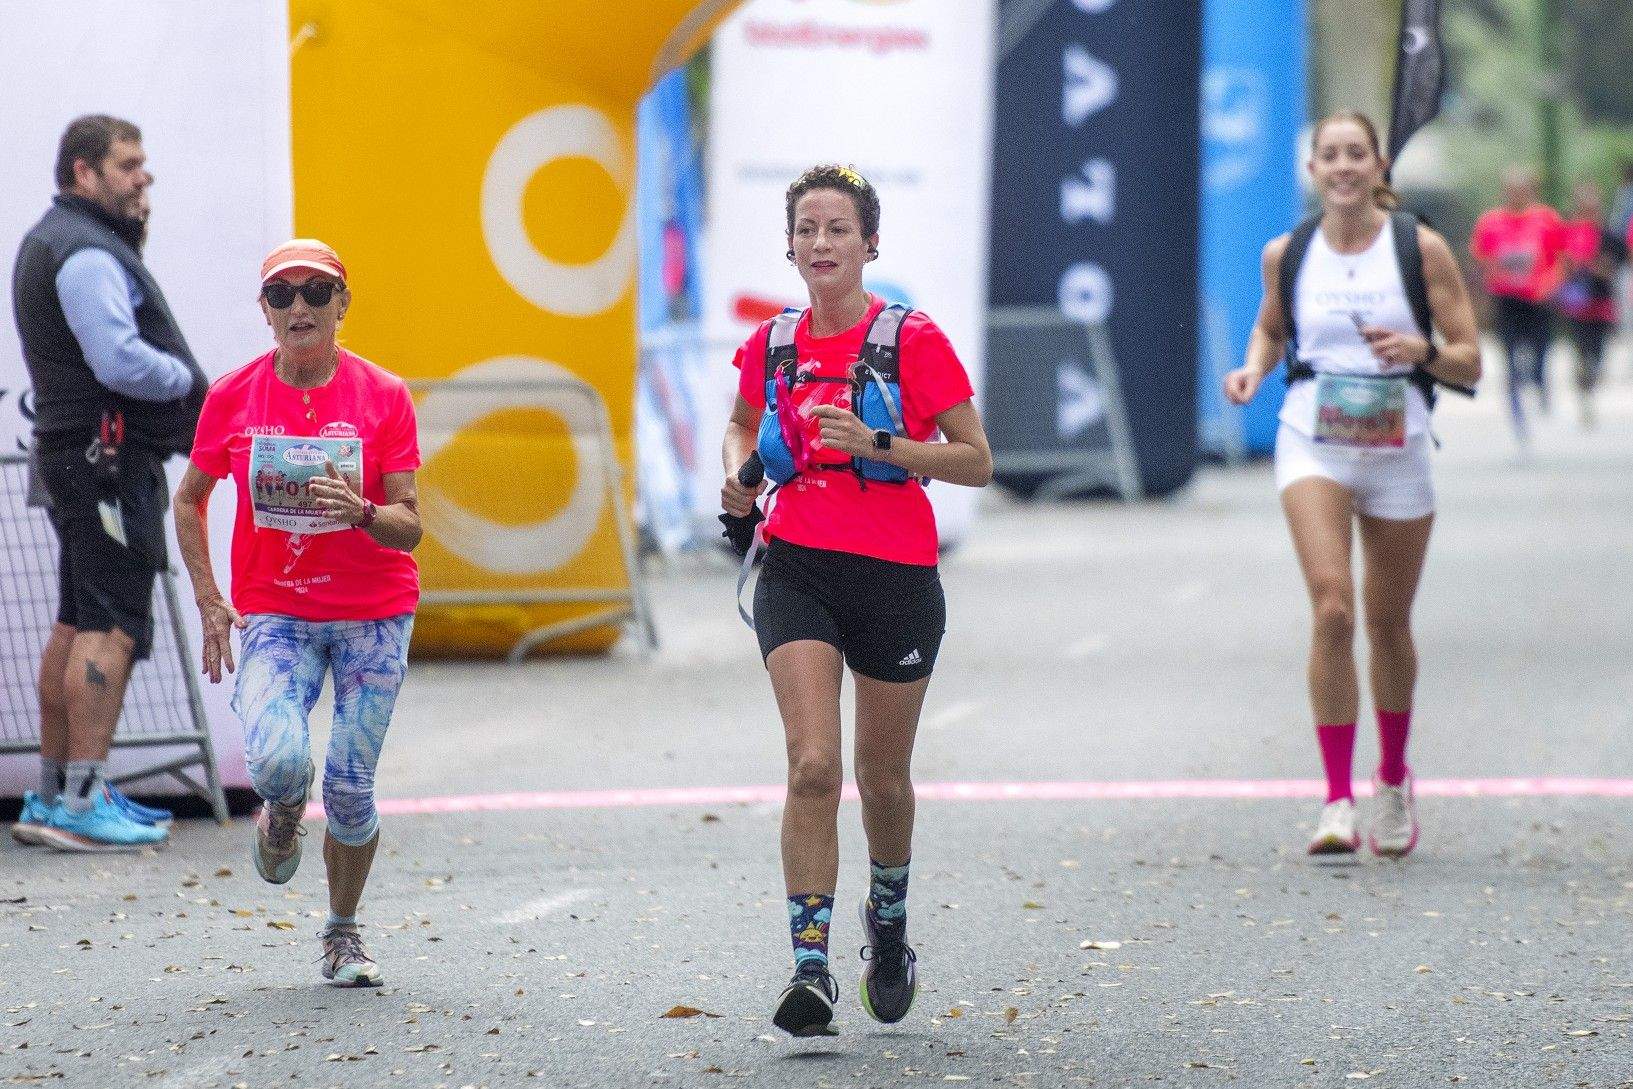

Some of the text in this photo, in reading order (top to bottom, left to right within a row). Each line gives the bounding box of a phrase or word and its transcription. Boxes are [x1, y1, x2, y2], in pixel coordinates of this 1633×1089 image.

[1057, 0, 1118, 437] VOLV
[245, 425, 285, 436] OYSHO
[286, 450, 326, 461] ASTURIANA
[265, 515, 297, 527] OYSHO
[311, 575, 331, 583] MUJER
[899, 657, 922, 666] adidas
